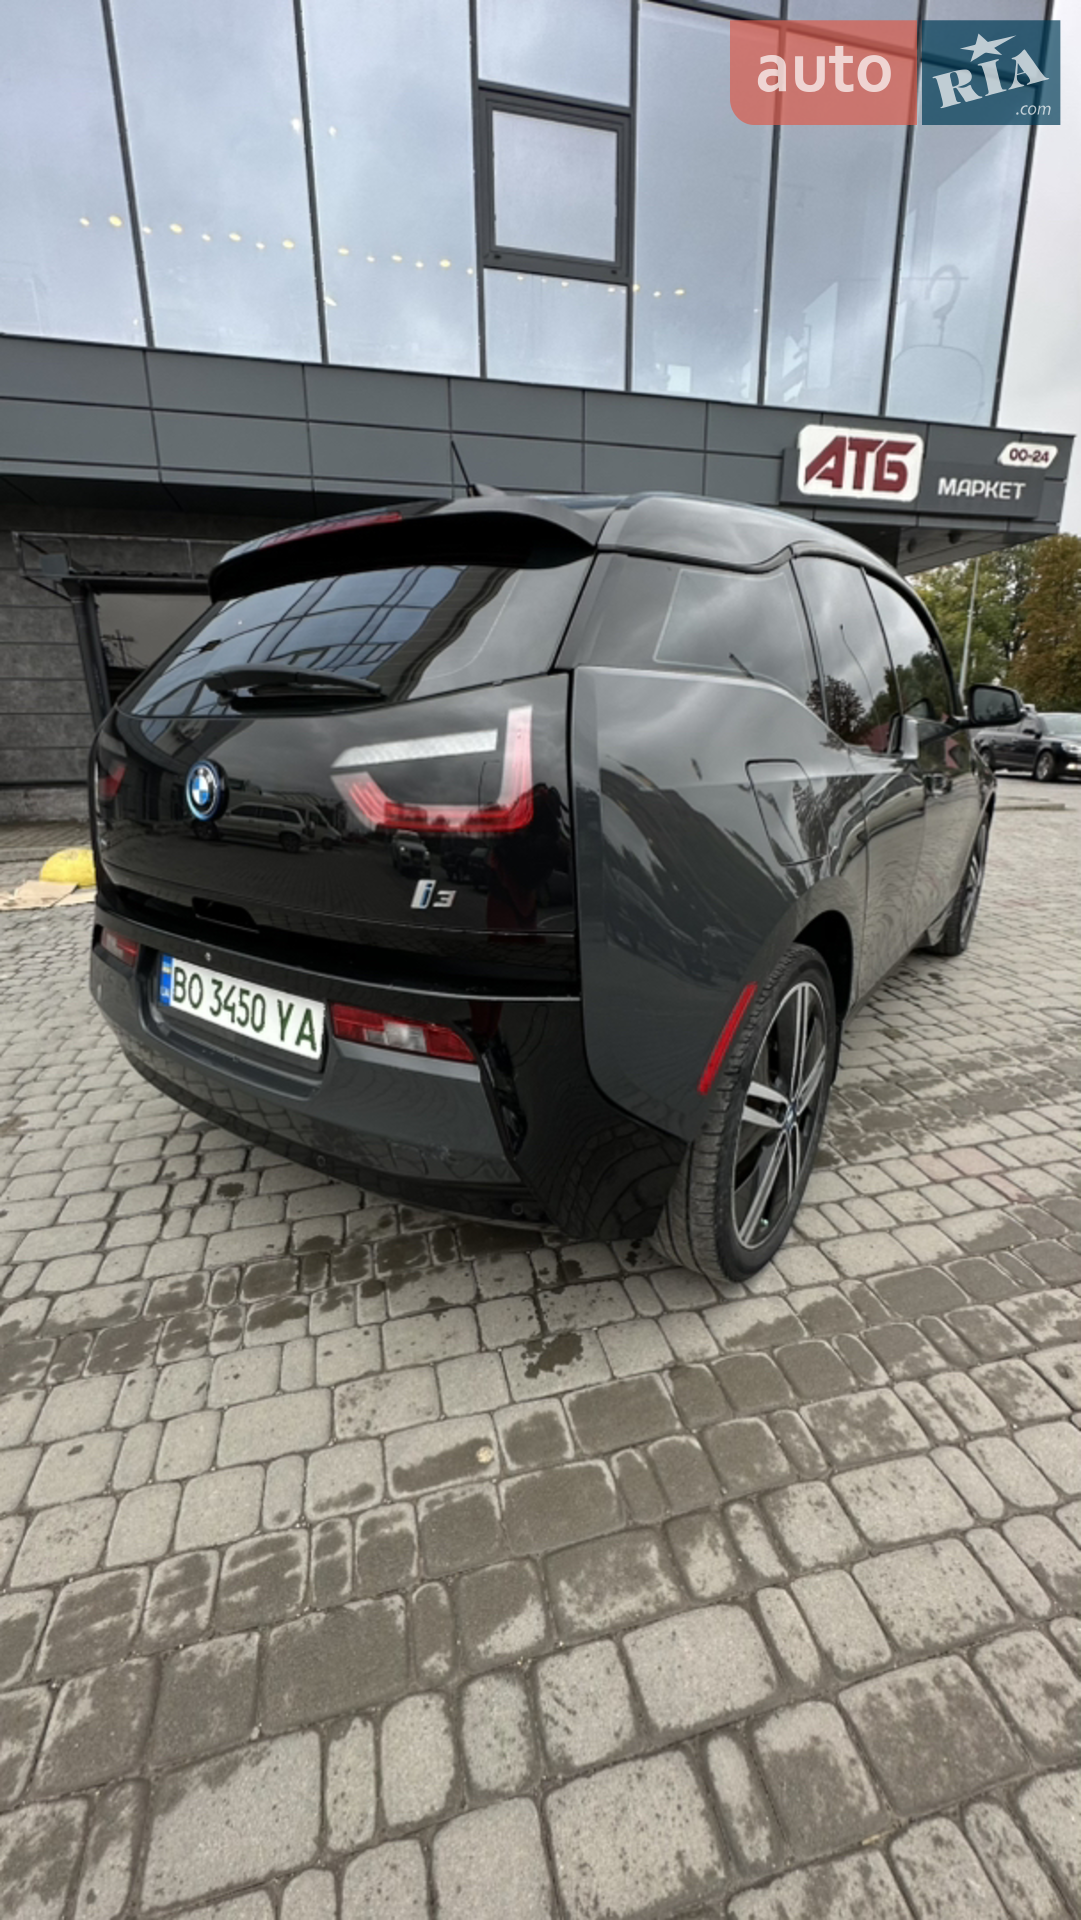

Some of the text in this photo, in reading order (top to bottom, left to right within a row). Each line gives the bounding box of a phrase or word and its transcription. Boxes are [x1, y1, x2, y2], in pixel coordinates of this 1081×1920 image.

[803, 435, 917, 493] АТБ
[1008, 447, 1050, 464] 00-24
[937, 477, 1027, 501] МАРКЕТ
[410, 879, 457, 909] i3
[172, 966, 317, 1052] BO 3450 YA
